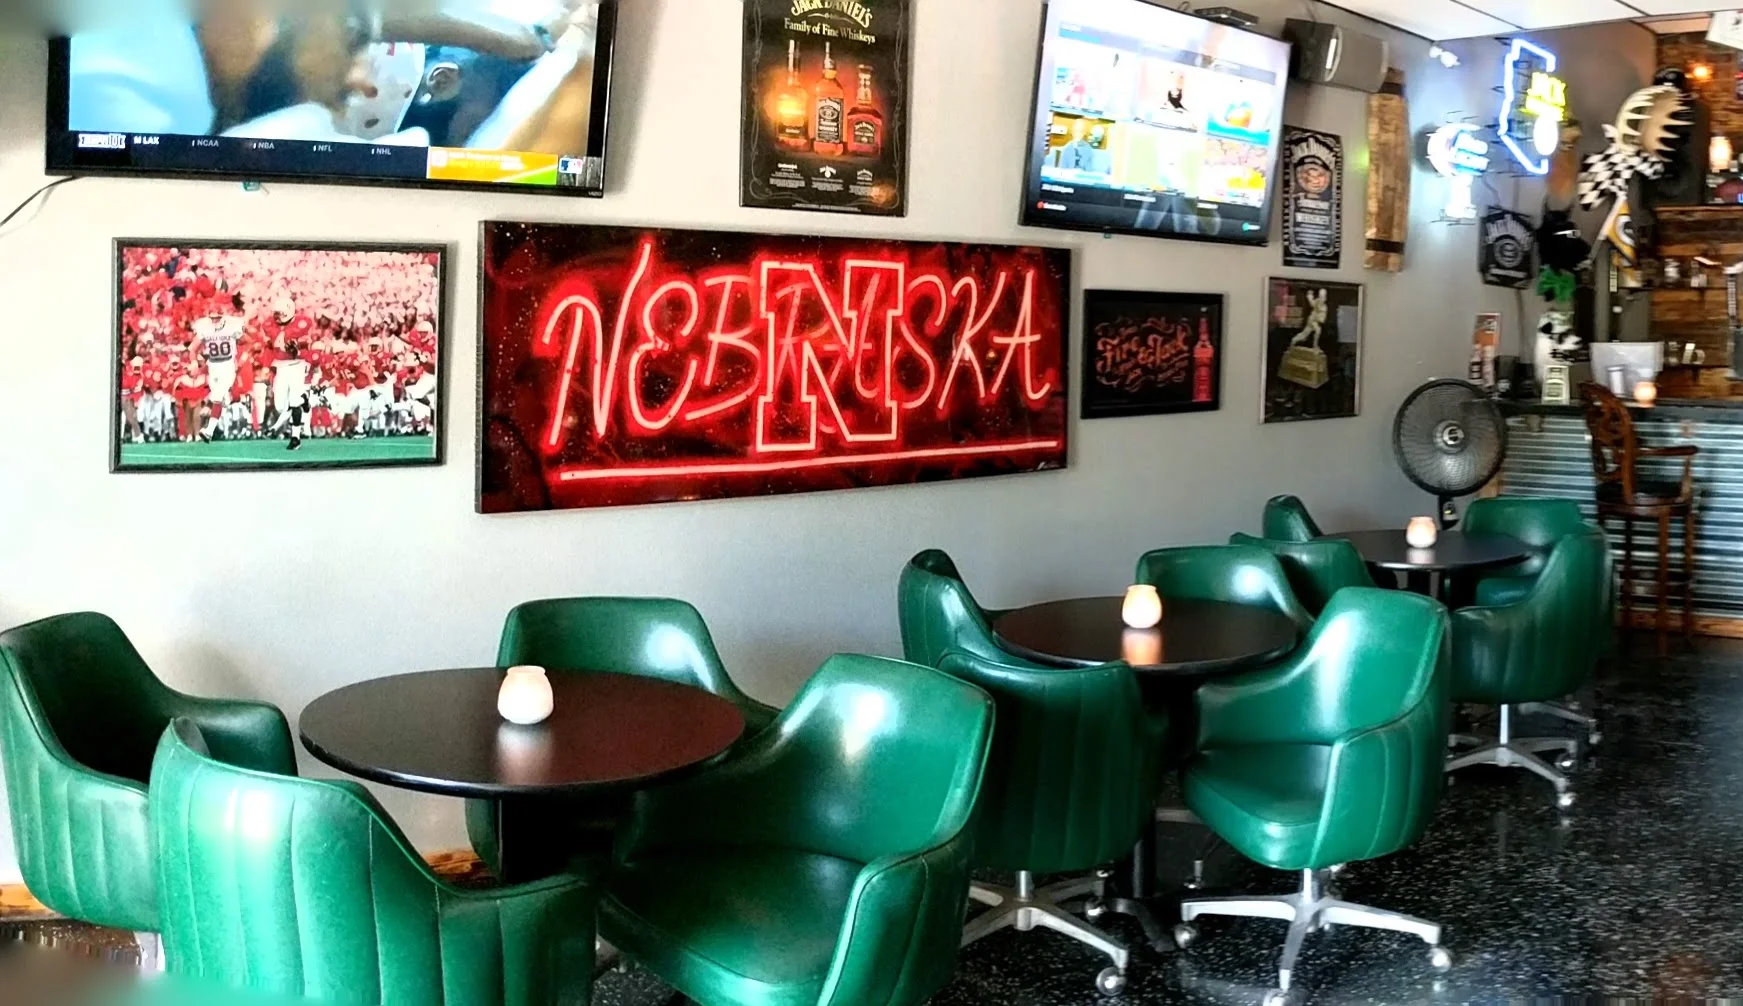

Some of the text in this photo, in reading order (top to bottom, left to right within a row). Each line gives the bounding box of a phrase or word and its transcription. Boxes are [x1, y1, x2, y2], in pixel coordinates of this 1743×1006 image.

[784, 17, 876, 44] Family of Fine Whiskeys
[197, 139, 219, 147] NCAA
[258, 141, 275, 150] NBA
[318, 144, 333, 152] NFL
[376, 147, 392, 155] NHL
[208, 341, 231, 357] 80
